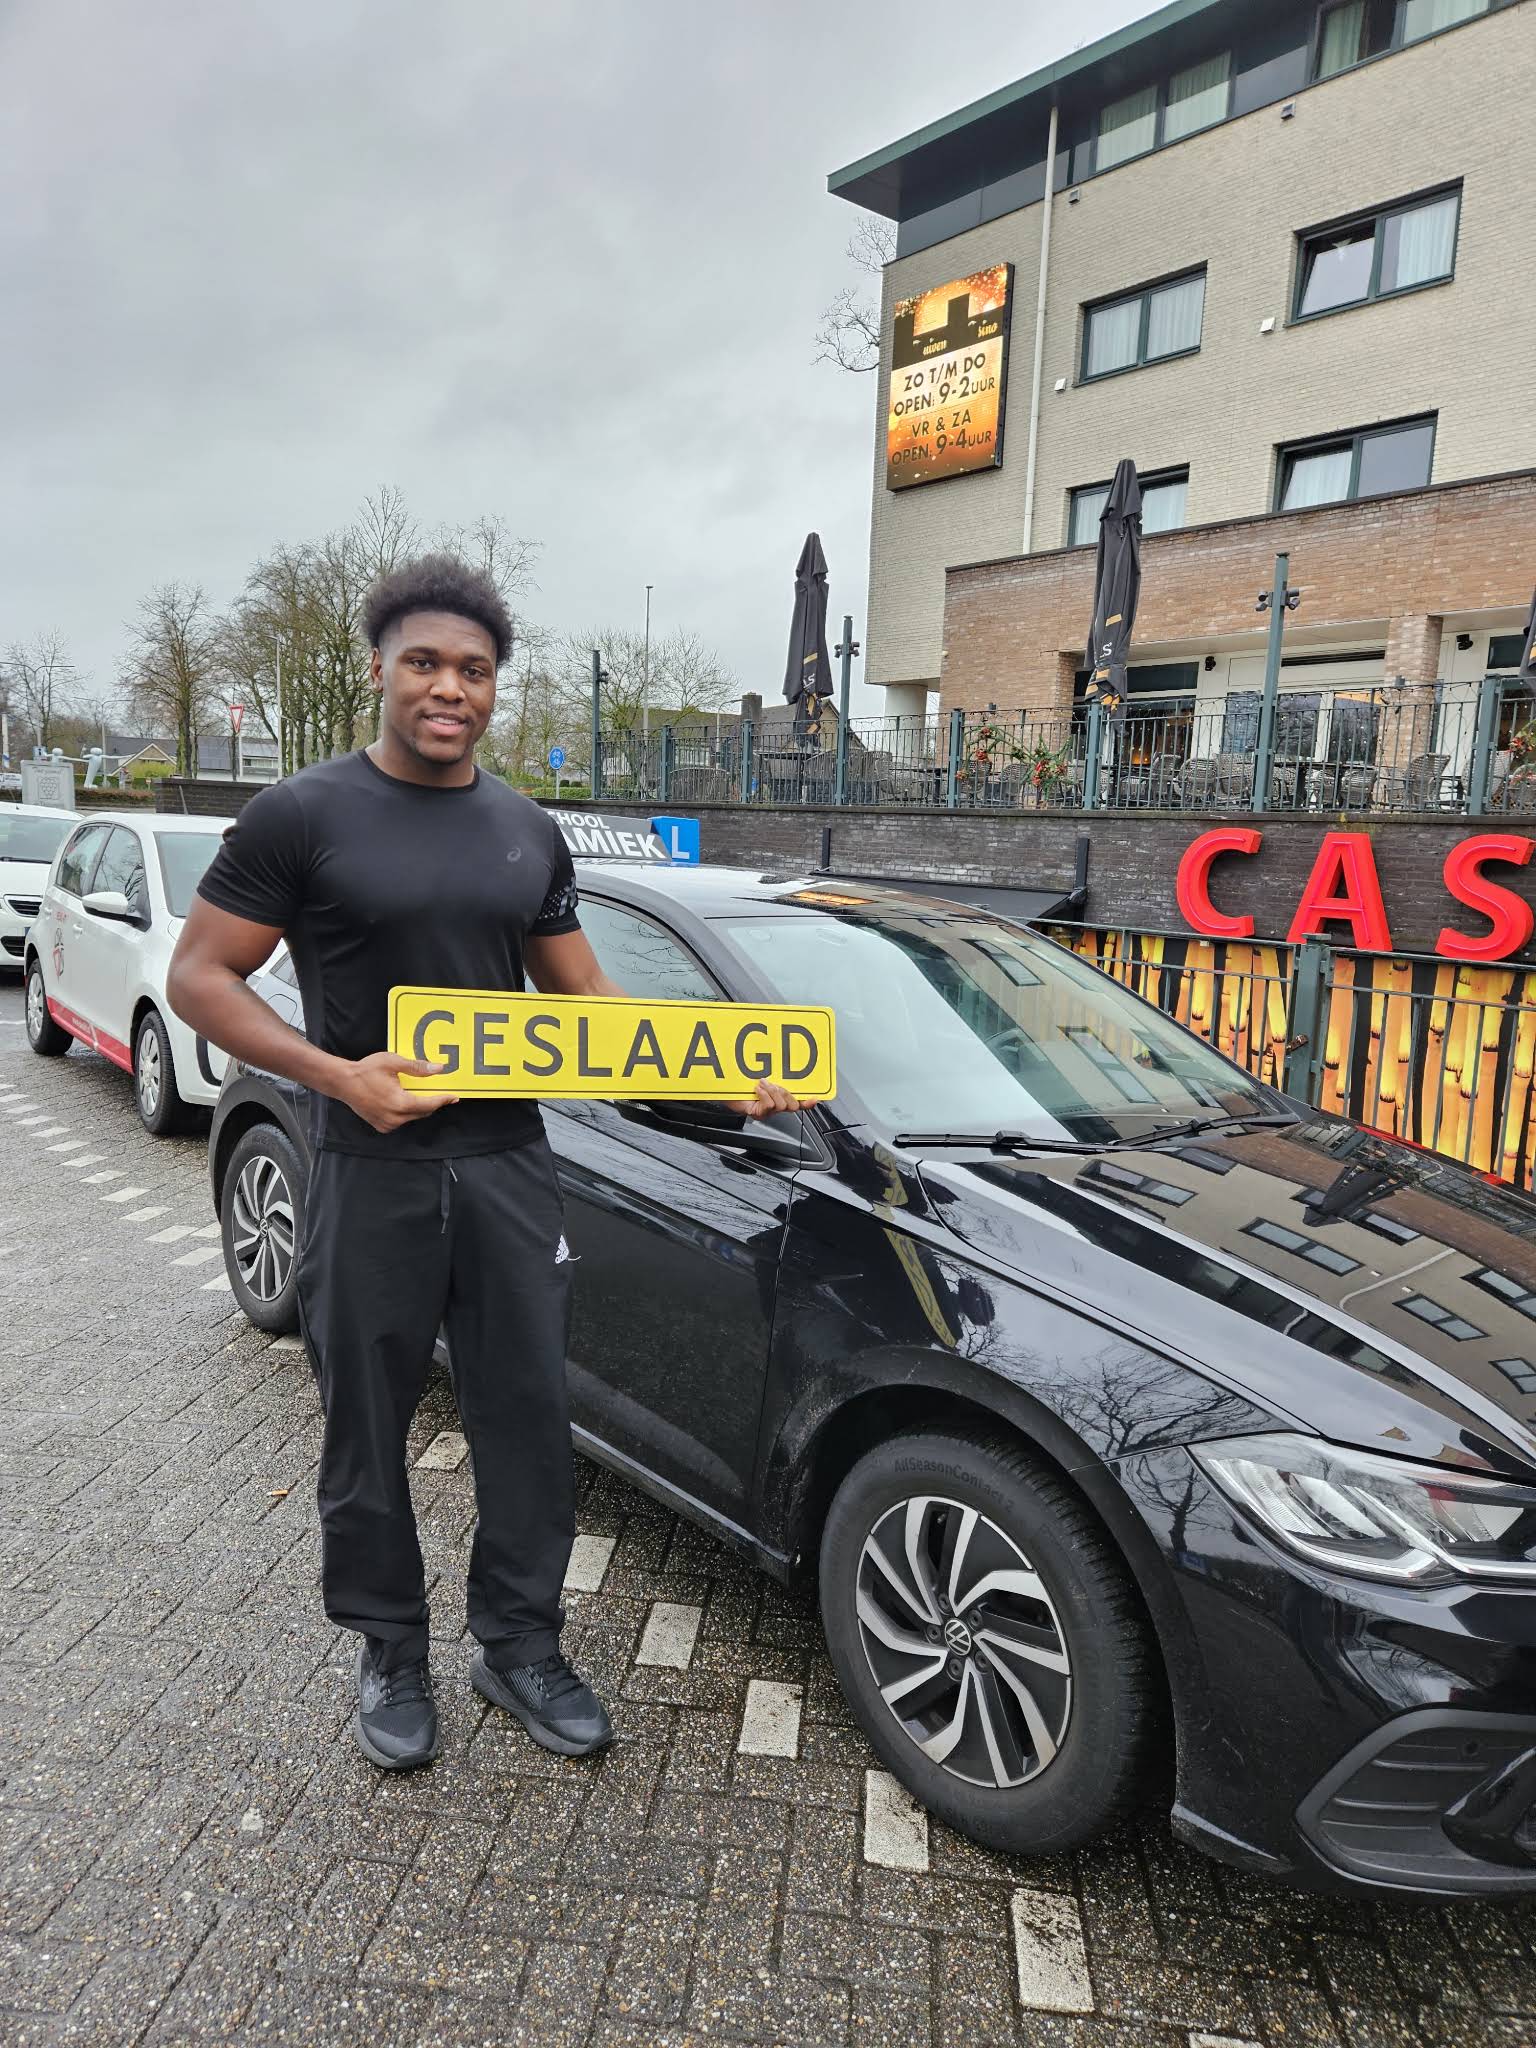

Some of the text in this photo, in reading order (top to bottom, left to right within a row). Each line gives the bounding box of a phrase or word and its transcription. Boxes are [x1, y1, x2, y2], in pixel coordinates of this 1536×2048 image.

[904, 352, 986, 392] ZO T/M DO
[893, 394, 935, 417] OPEN:
[912, 408, 972, 438] VR & ZA
[891, 443, 933, 466] OPEN:
[671, 825, 690, 859] L
[1176, 827, 1536, 962] CAS
[412, 1009, 818, 1080] GESLAAGD
